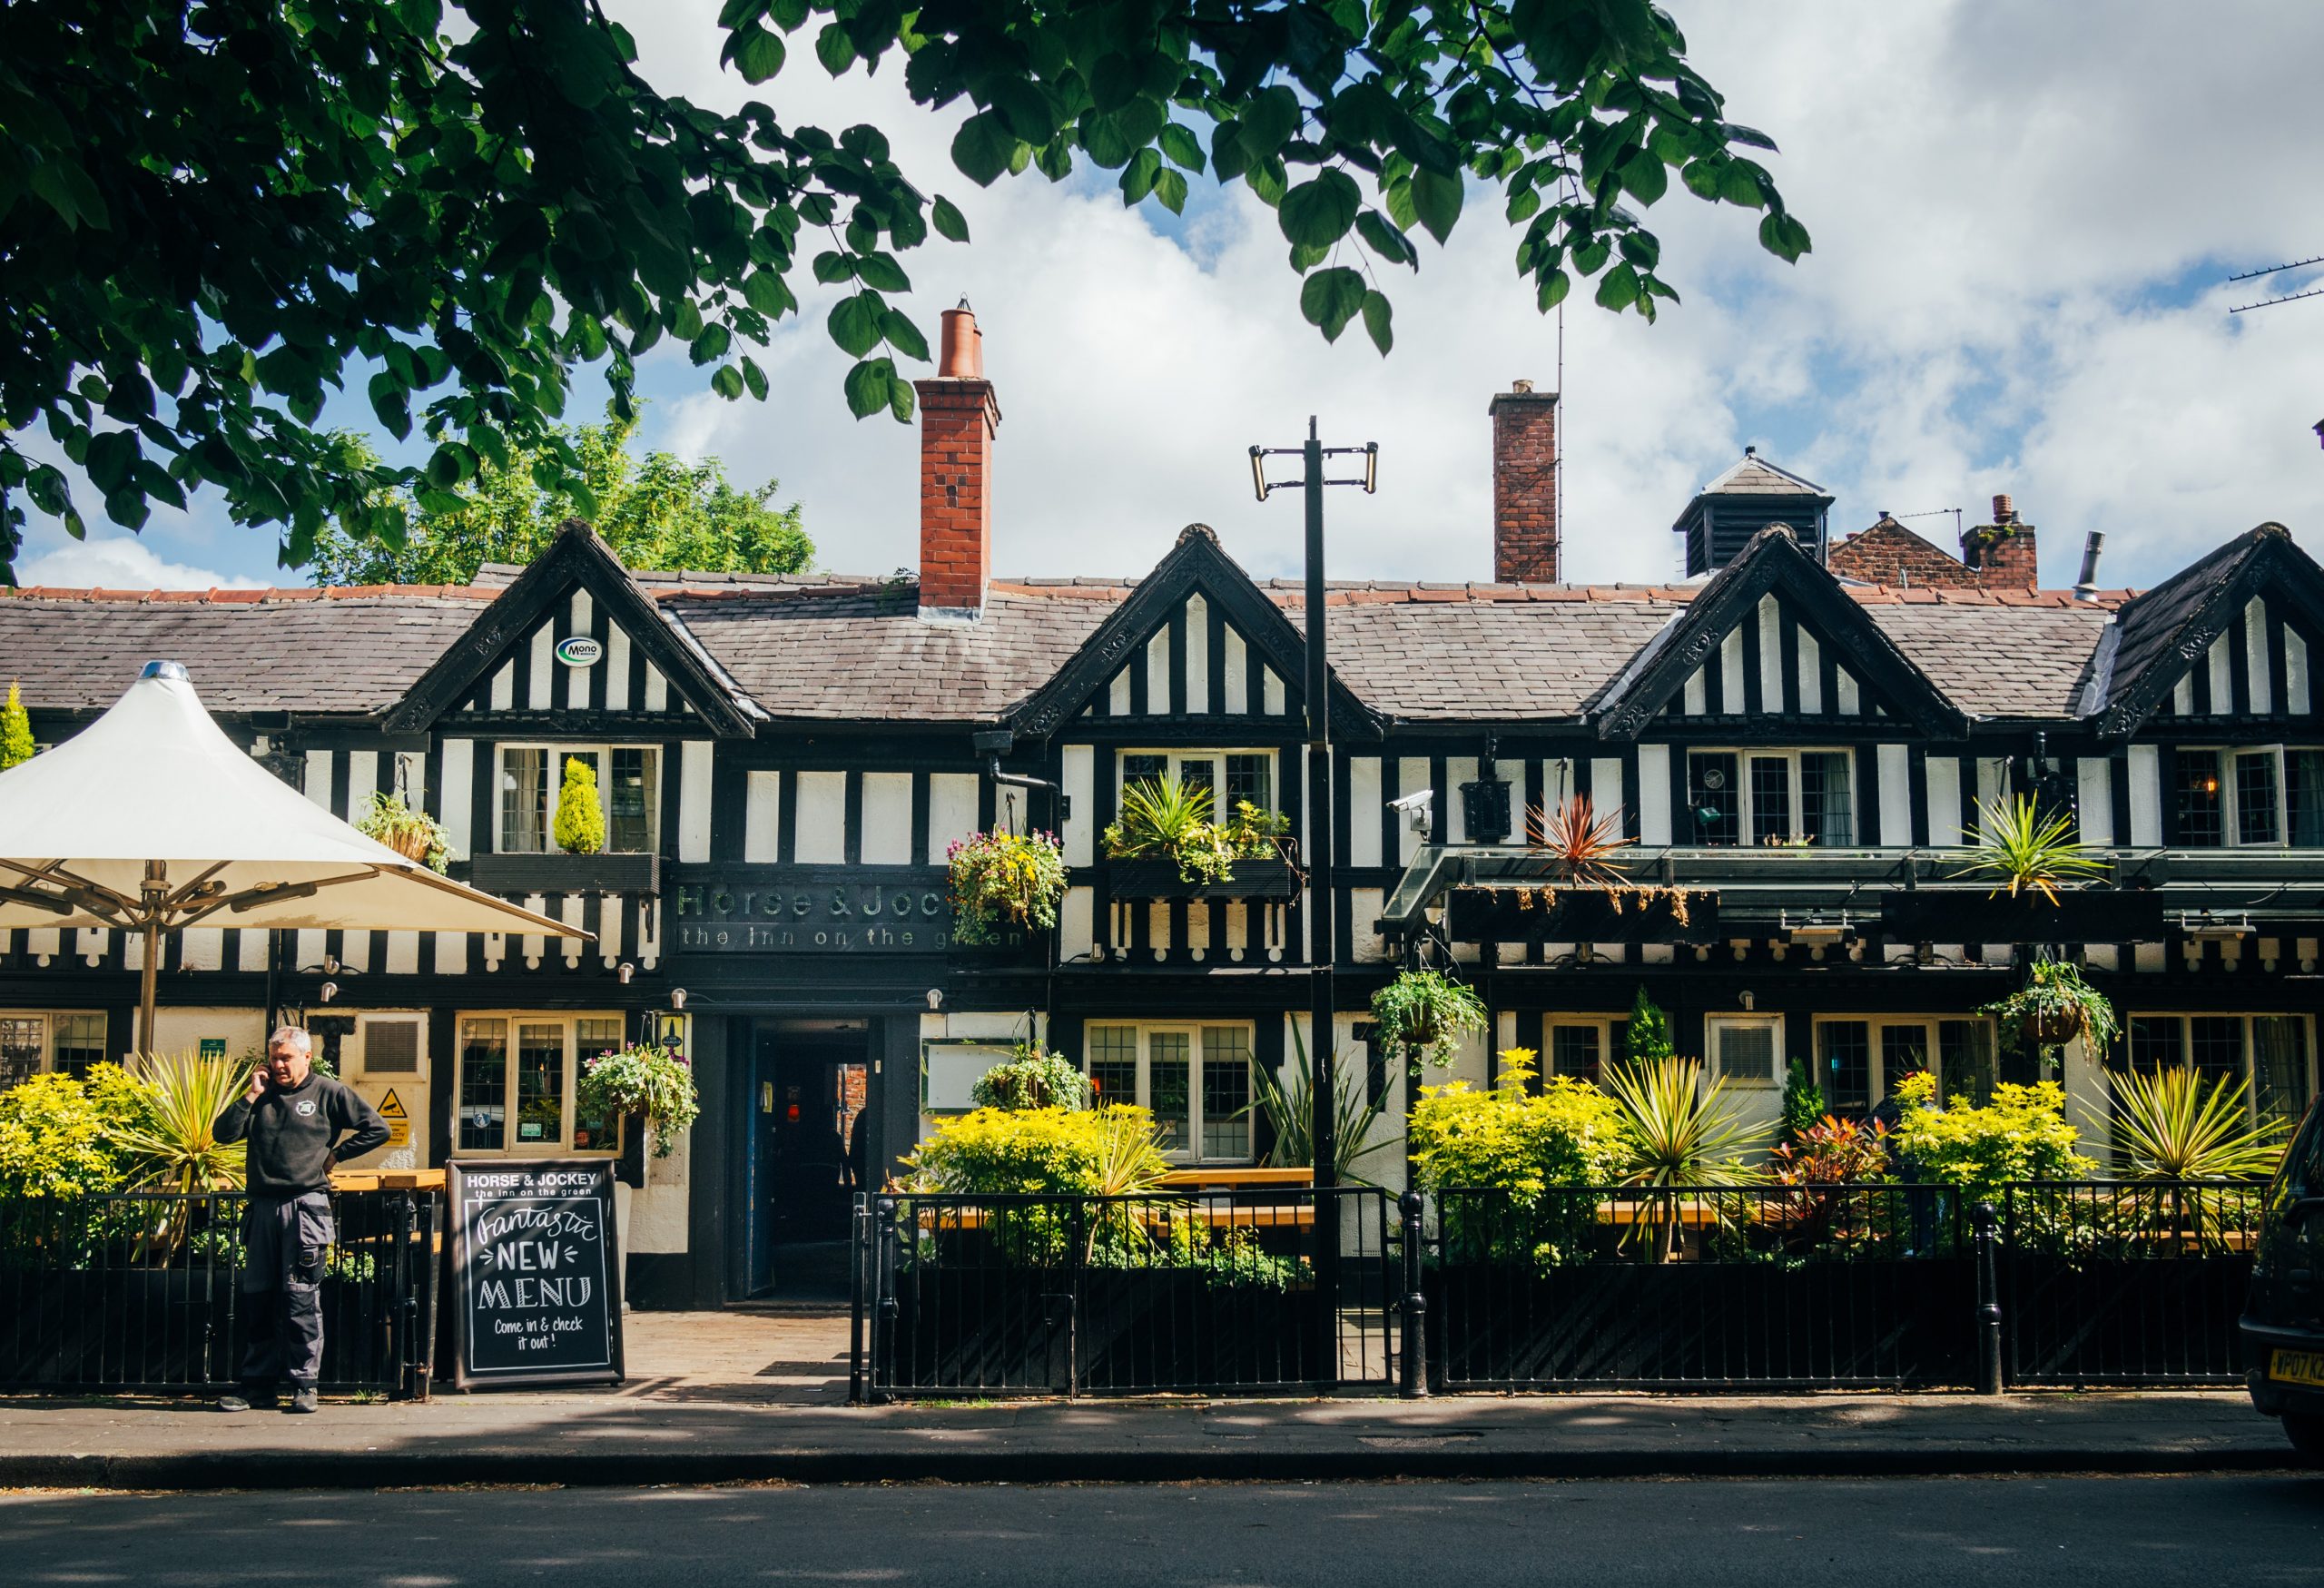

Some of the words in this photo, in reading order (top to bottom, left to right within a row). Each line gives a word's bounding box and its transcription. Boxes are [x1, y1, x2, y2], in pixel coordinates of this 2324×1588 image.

[568, 646, 596, 655] Mono
[678, 886, 812, 915] Horse
[683, 927, 728, 945] the
[749, 926, 794, 947] inn
[814, 931, 847, 945] on
[867, 928, 912, 945] the
[468, 1175, 519, 1188] HORSE
[523, 1175, 535, 1186] &
[537, 1173, 596, 1186] JOCKEY
[475, 1189, 493, 1198] the
[538, 1188, 556, 1196] the
[561, 1188, 592, 1197] green
[497, 1240, 559, 1271] NEW
[478, 1277, 590, 1308] MENU
[495, 1318, 524, 1334] Come
[527, 1318, 537, 1332] in
[540, 1317, 549, 1331] &
[553, 1316, 584, 1331] check
[518, 1336, 527, 1350] it
